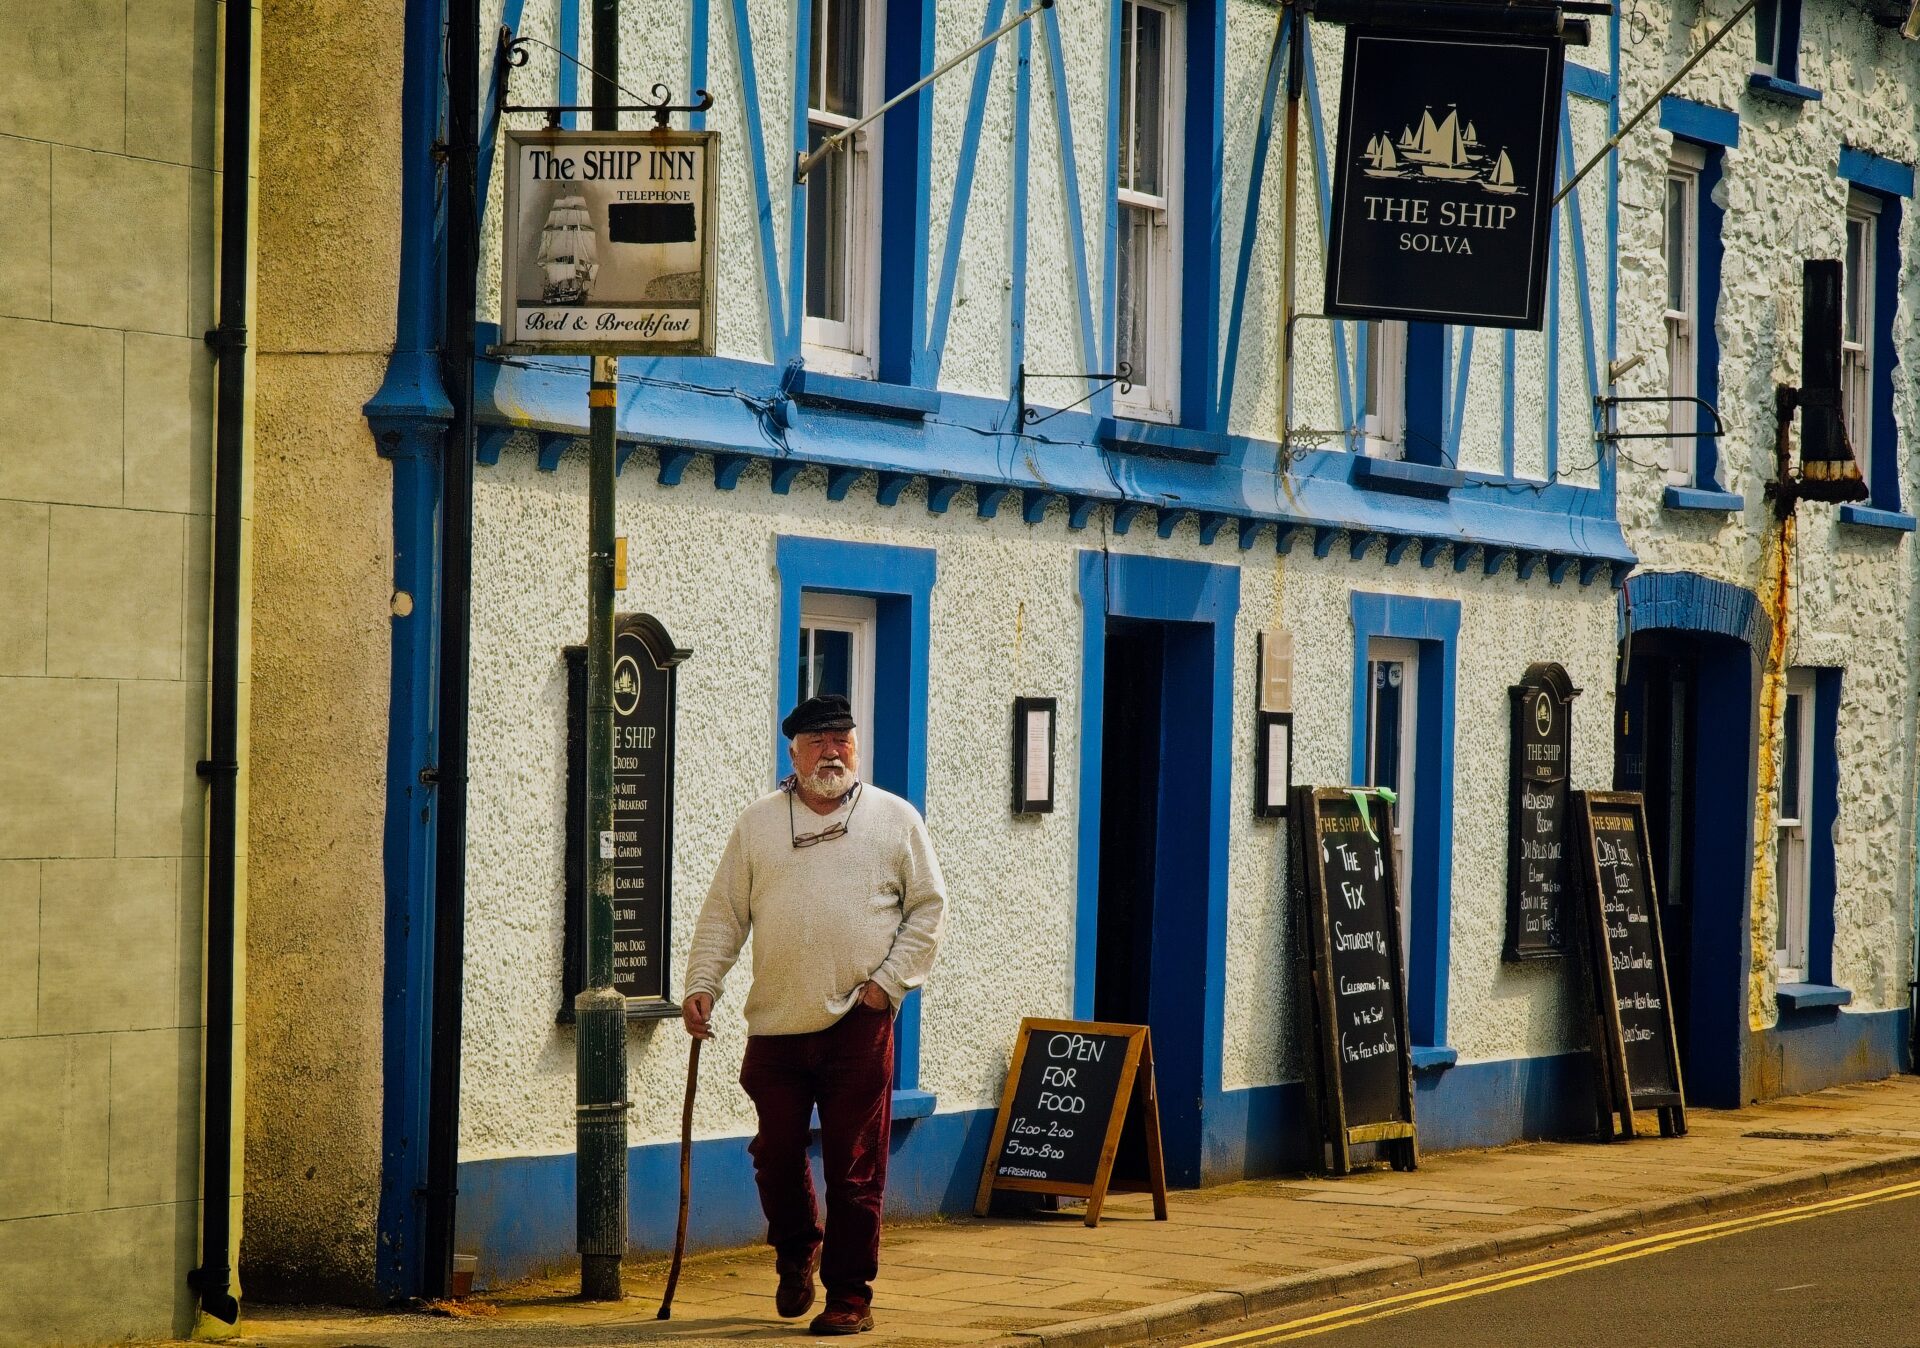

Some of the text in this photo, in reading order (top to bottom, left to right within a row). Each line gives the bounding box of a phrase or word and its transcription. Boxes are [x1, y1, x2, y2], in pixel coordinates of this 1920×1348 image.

[529, 150, 695, 181] The SHIP INN
[617, 190, 691, 201] TELEPHONE
[1364, 196, 1517, 230] THE SHIP
[1399, 232, 1473, 255] SOLVA
[525, 312, 691, 338] Bed & Breakfast
[625, 727, 656, 749] SHIP
[1527, 744, 1560, 761] THE SHIP
[621, 783, 636, 795] SUITE
[618, 799, 648, 811] BREAKFAST
[1319, 817, 1377, 832] THE SHIP IN
[1605, 816, 1620, 830] SHIP
[1620, 816, 1634, 831] INN
[613, 831, 638, 842] IVERSIDE
[618, 845, 642, 857] GARDEN
[1336, 843, 1361, 871] THE
[1596, 837, 1617, 861] OPEN
[616, 877, 645, 889] CASK ALES
[1341, 882, 1366, 910] FIX
[623, 909, 636, 920] WIFI
[1335, 921, 1374, 951] SATURDAY
[630, 939, 646, 951] DOGS
[614, 956, 648, 967] KING BOOTS
[614, 972, 635, 983] ELCOME
[1048, 1034, 1106, 1062] OPEN
[1041, 1066, 1077, 1088] FOR
[1037, 1092, 1085, 1114] FOOD
